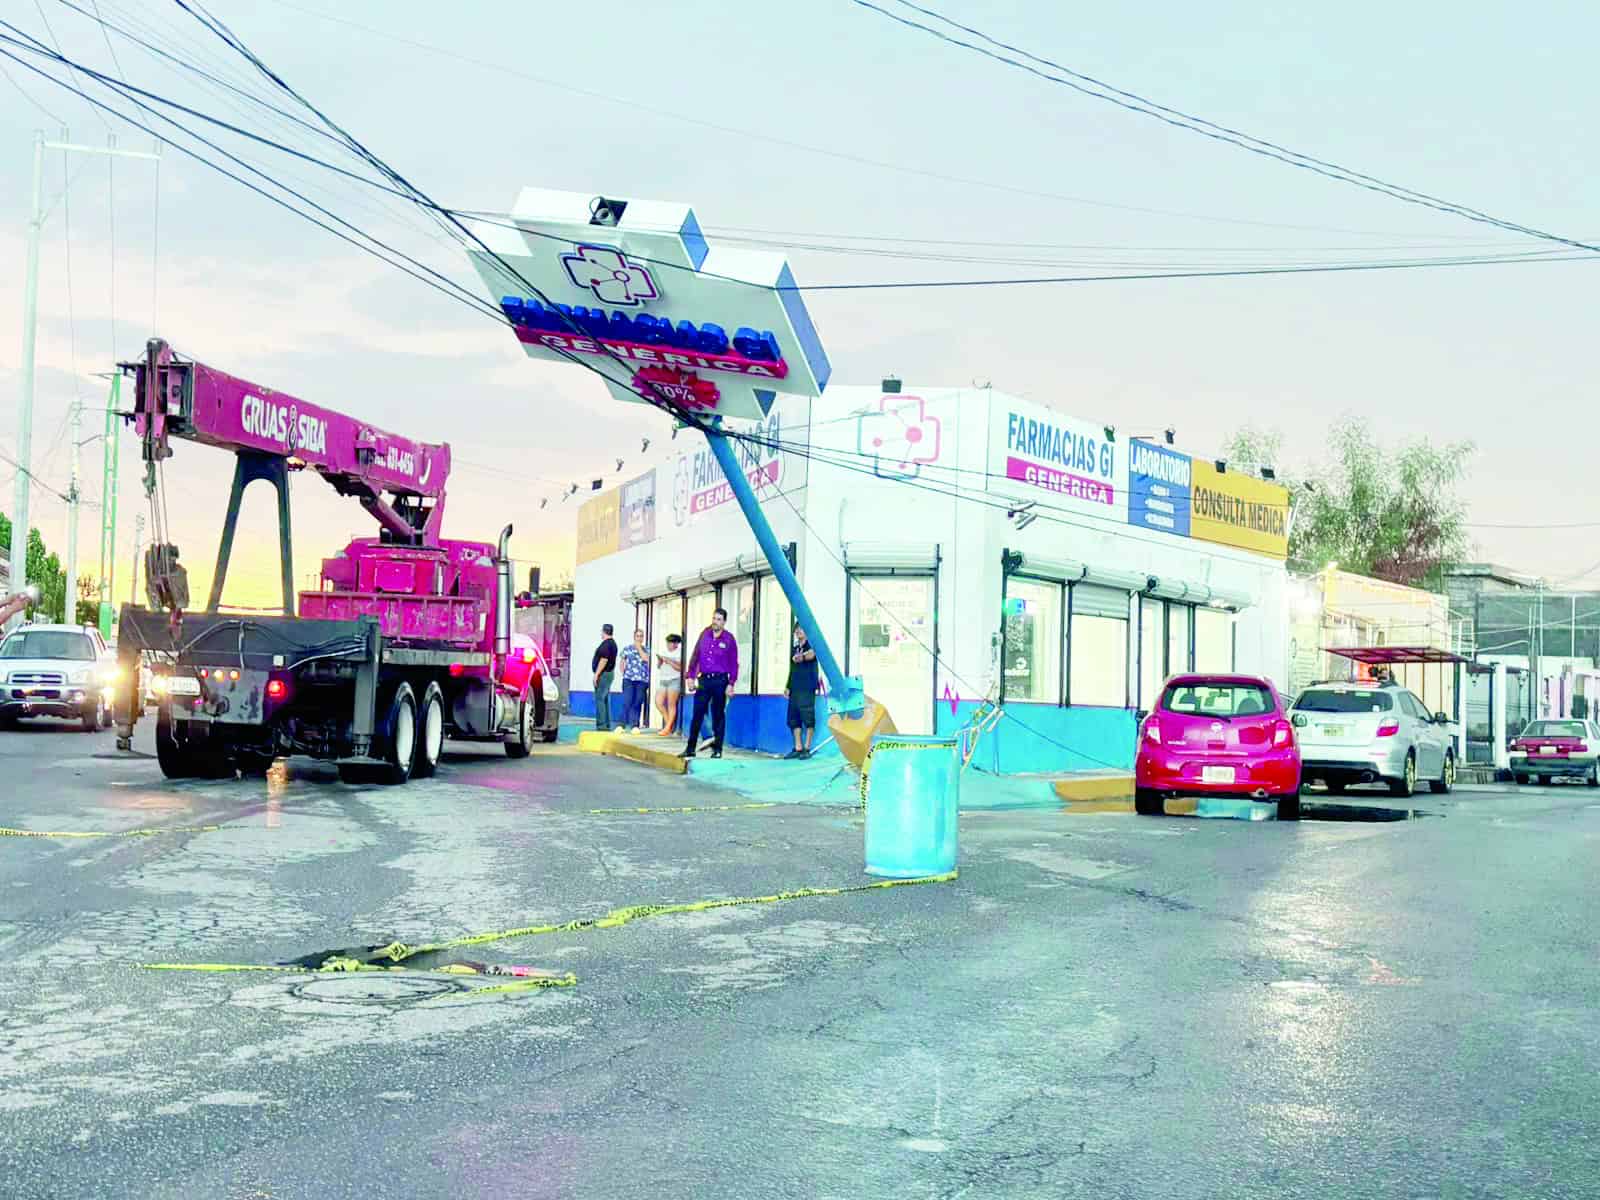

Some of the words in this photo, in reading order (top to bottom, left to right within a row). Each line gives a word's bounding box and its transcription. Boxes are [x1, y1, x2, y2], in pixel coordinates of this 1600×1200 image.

[242, 394, 288, 443] GRUAS
[1008, 411, 1096, 473] FARMACIAS
[1100, 442, 1114, 479] GI
[1129, 443, 1190, 488] LABORATORIO
[1193, 484, 1246, 527] CONSULTA
